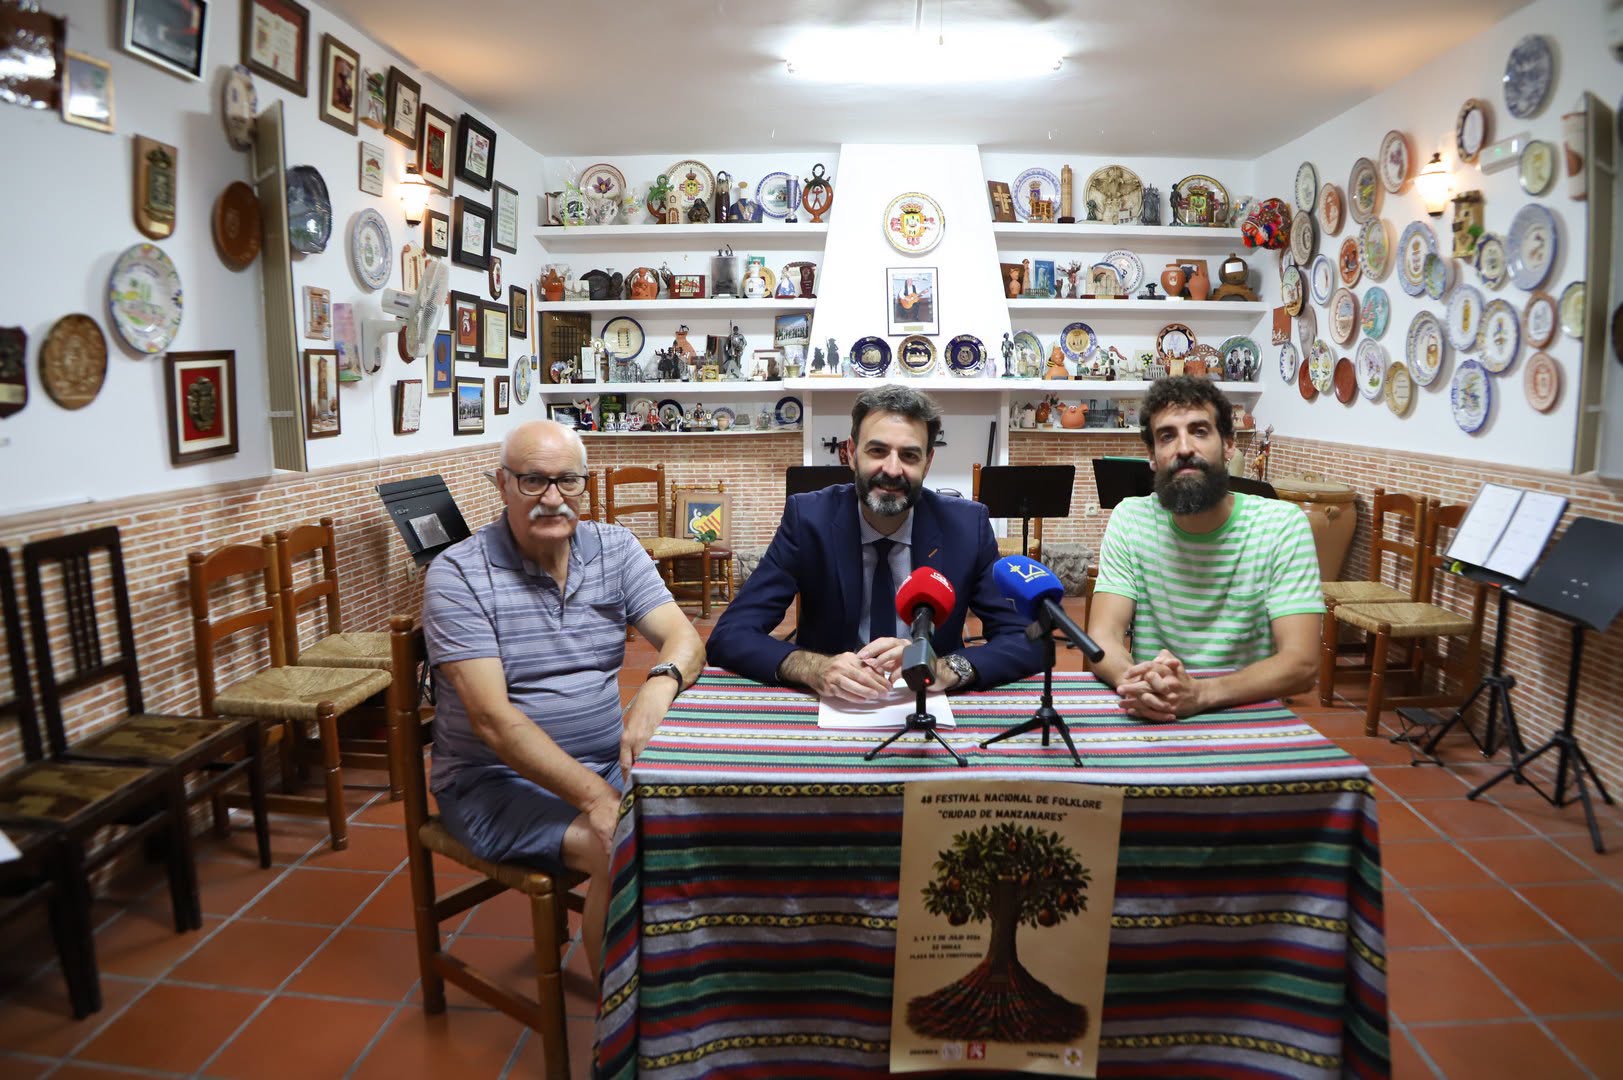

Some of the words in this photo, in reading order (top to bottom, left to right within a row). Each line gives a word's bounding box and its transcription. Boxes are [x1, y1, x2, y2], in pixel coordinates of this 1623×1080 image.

[935, 793, 980, 804] FESTIVAL
[984, 793, 1033, 804] NACIONAL
[1036, 795, 1049, 805] DE
[1052, 796, 1102, 810] FOLKLORE
[938, 809, 977, 819] "CIUDAD
[980, 809, 992, 819] DE
[995, 810, 1068, 822] MANZANARES"
